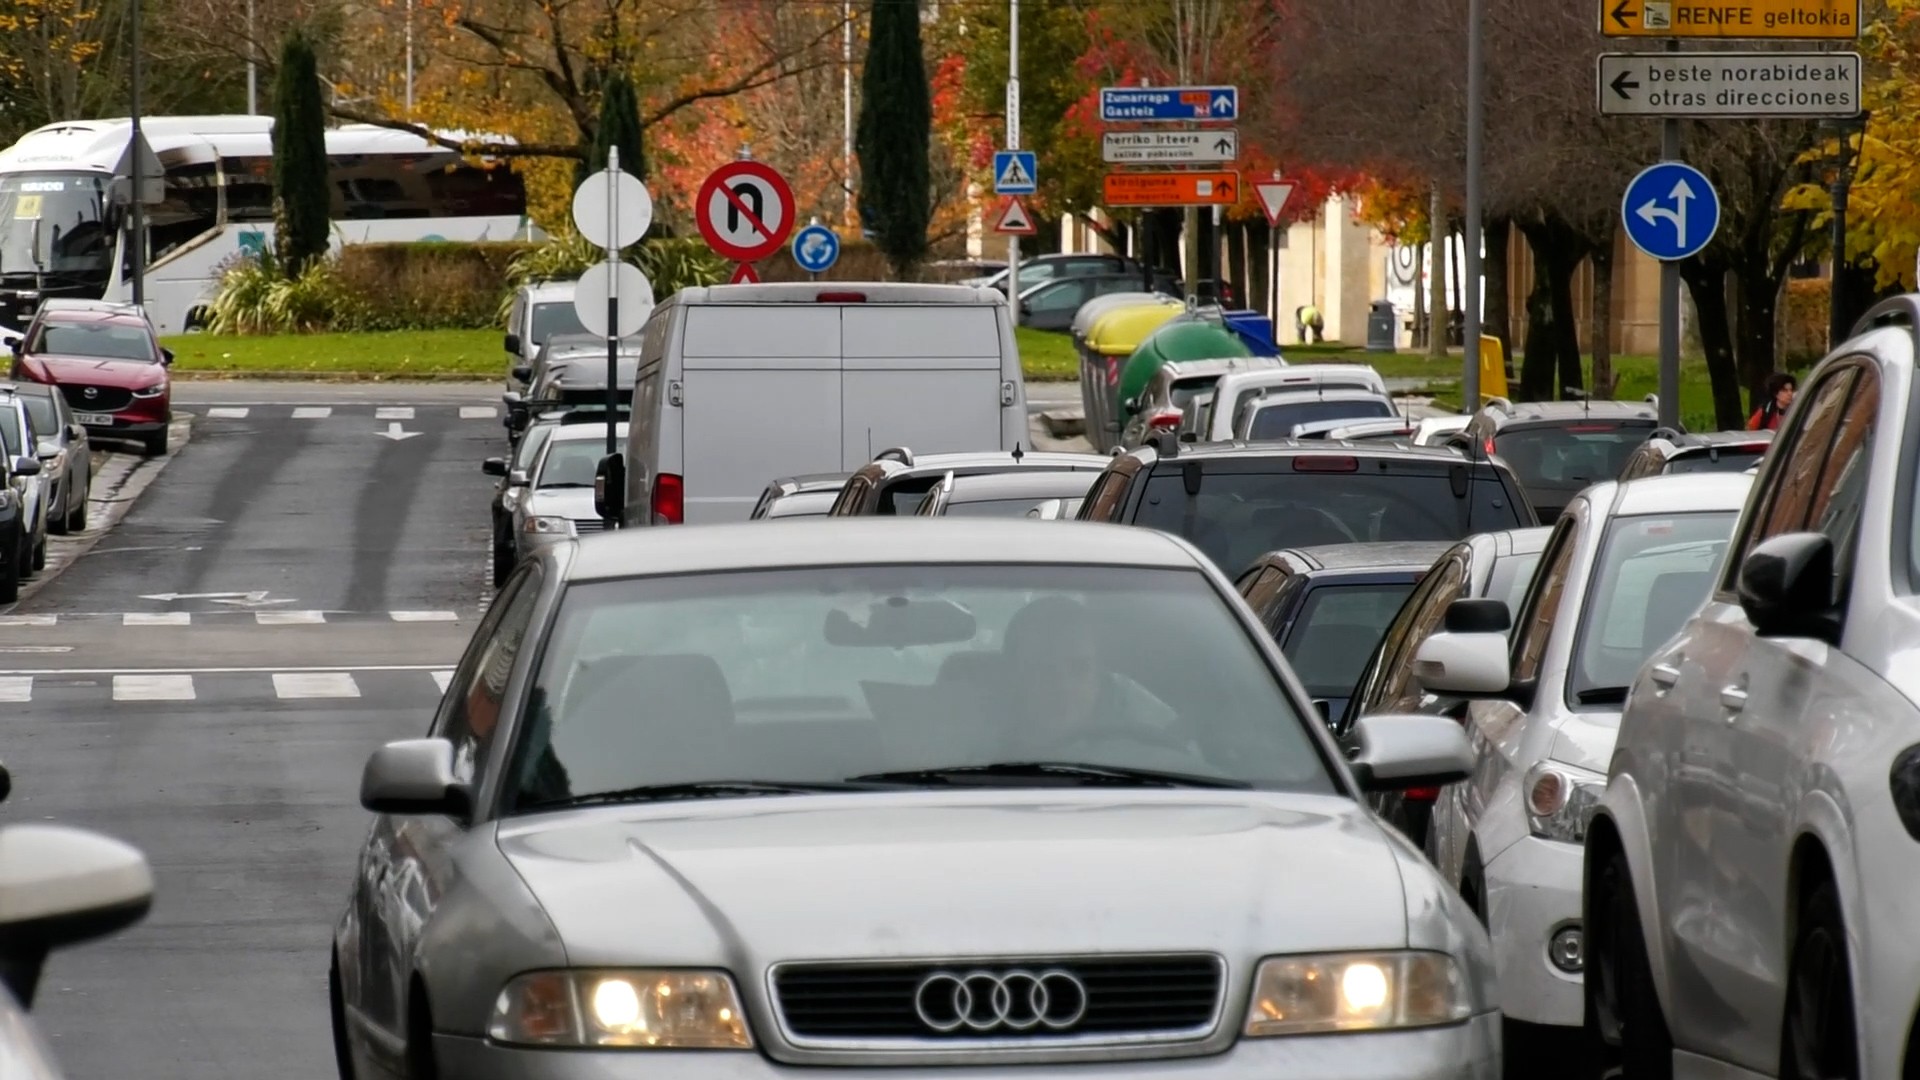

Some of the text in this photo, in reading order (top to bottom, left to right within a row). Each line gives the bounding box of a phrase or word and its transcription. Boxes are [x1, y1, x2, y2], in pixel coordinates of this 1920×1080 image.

[1677, 7, 1850, 28] RENFE geltokia
[1649, 64, 1850, 82] beste norabideak
[1105, 92, 1170, 104] Zumarraga
[1649, 88, 1850, 106] otras direcciones
[1105, 106, 1154, 117] Gasteiz
[1106, 135, 1200, 145] herriko irteera
